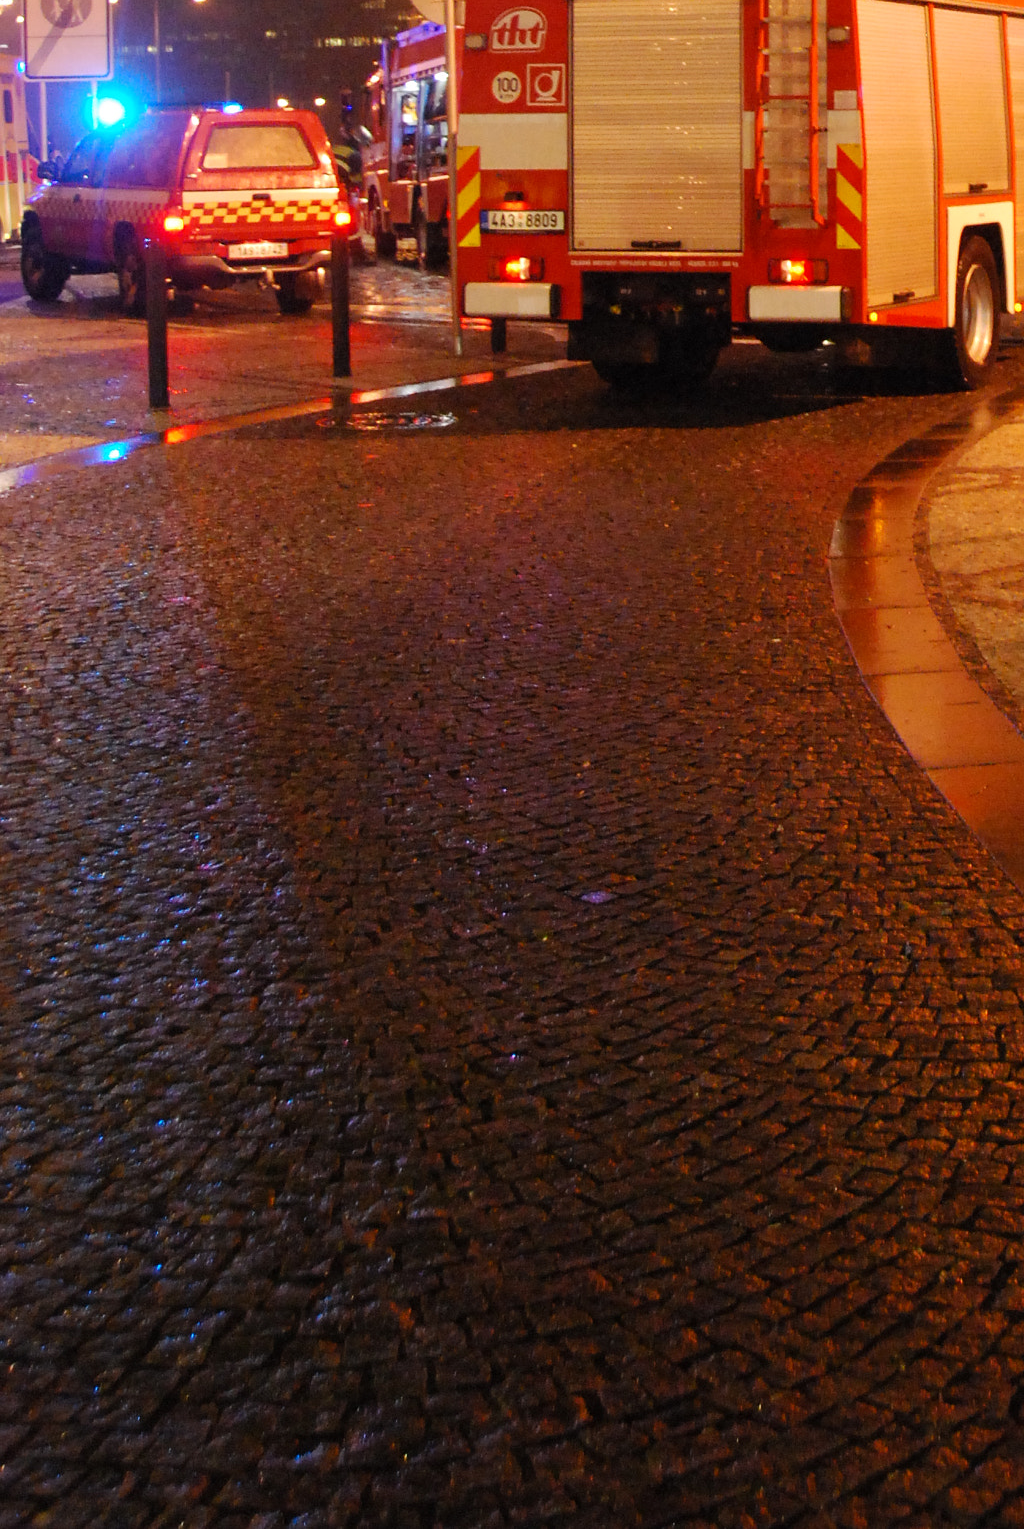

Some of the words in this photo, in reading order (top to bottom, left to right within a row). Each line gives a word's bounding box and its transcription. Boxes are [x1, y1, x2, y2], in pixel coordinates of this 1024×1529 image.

[497, 77, 519, 92] 100
[492, 213, 515, 228] 4A3
[526, 213, 557, 228] 8809
